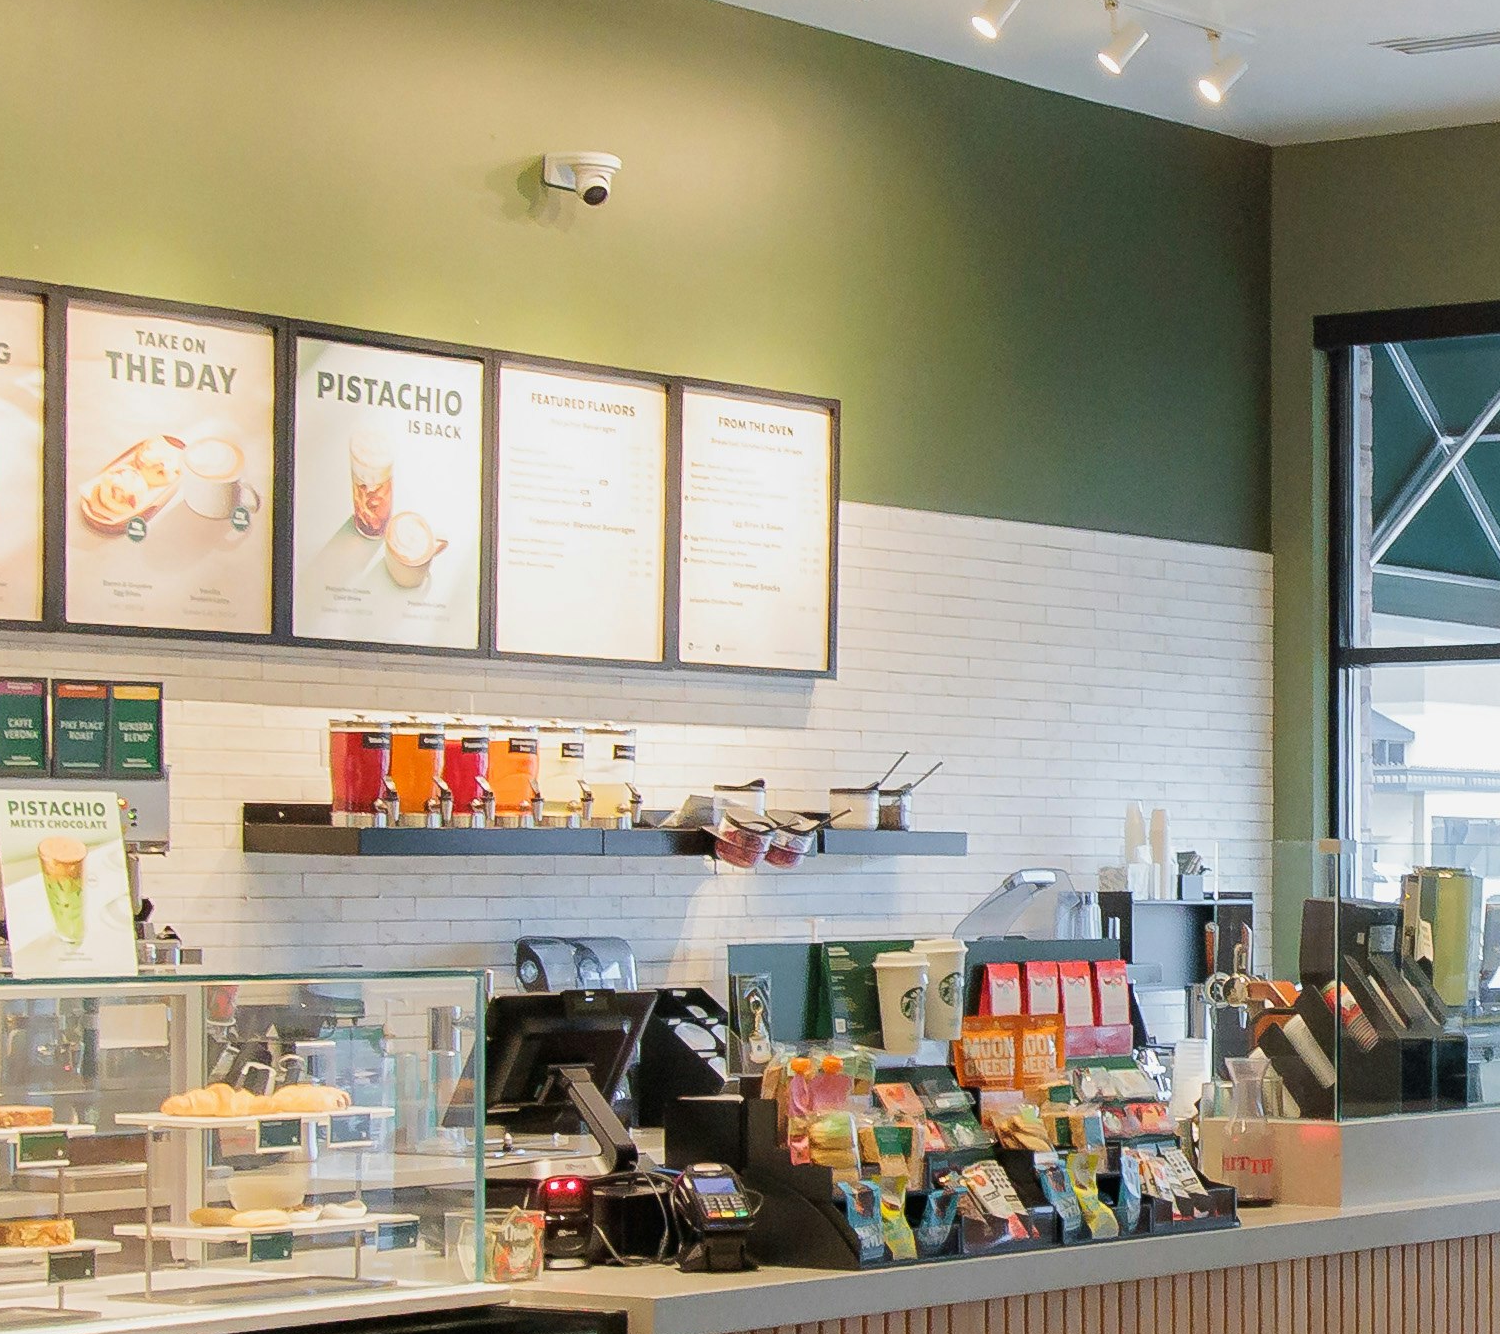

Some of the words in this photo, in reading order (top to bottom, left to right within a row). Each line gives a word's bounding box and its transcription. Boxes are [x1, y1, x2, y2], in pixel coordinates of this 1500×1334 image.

[135, 329, 179, 350] TAKE
[182, 335, 207, 355] ON
[105, 349, 167, 387] THE
[174, 359, 238, 396] DAY
[315, 369, 463, 418] PISTACHIO
[530, 391, 586, 412] FEATURED
[588, 399, 637, 418] FLAVORS
[407, 419, 422, 436] IS
[424, 421, 462, 441] BACK
[718, 416, 747, 432] FROM
[748, 420, 767, 434] THE
[768, 423, 794, 437] OVEN
[3, 729, 39, 741] VERONA
[60, 720, 79, 731] PIKE
[79, 720, 105, 732] PLACE
[67, 730, 94, 742] ROAST
[7, 799, 106, 817] PISTACHIO
[9, 819, 45, 829] MEETS
[47, 819, 109, 831] CHOCOLATE
[963, 1035, 1015, 1059] MOON
